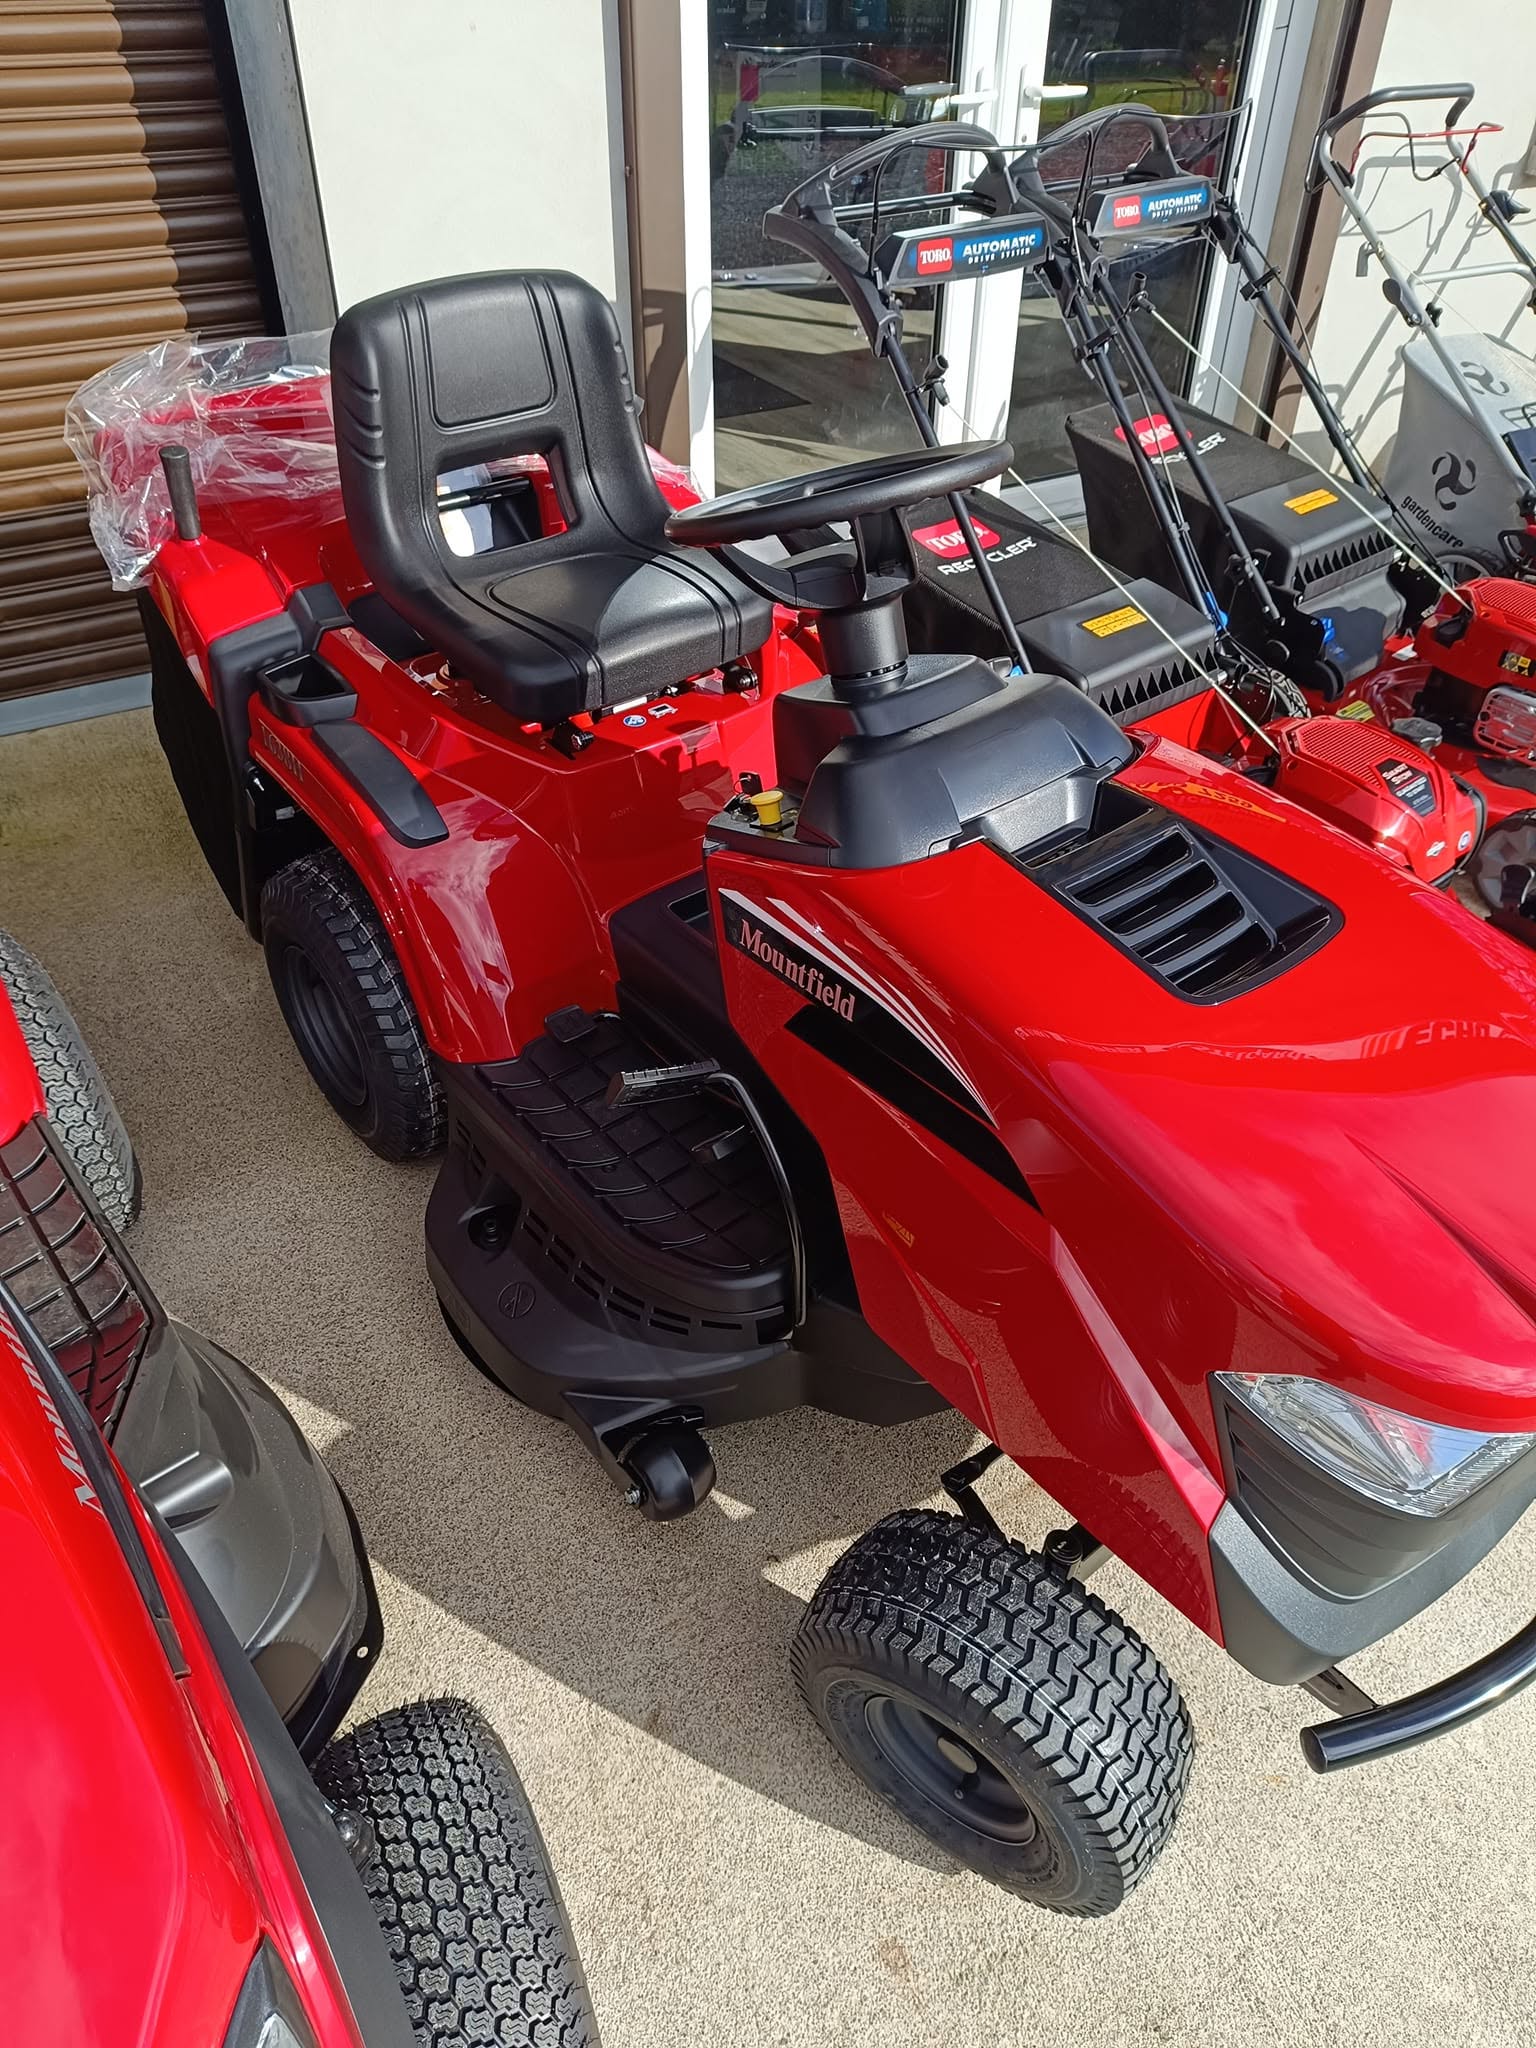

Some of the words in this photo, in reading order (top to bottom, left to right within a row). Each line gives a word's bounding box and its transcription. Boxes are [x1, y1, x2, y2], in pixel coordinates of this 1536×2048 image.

[1115, 205, 1140, 219] TORO
[1148, 193, 1203, 212] AUTOMATIC
[1151, 210, 1173, 219] DRIVE
[1176, 204, 1198, 214] SYSTEM
[962, 233, 1036, 258] AUTOMATIC
[920, 248, 952, 264] TORO
[968, 253, 996, 265] DRIVE
[1000, 247, 1031, 260] SYSTEM
[1400, 495, 1465, 548] gardencare
[937, 536, 1037, 576] RECCLER
[739, 919, 857, 1023] Mountfield
